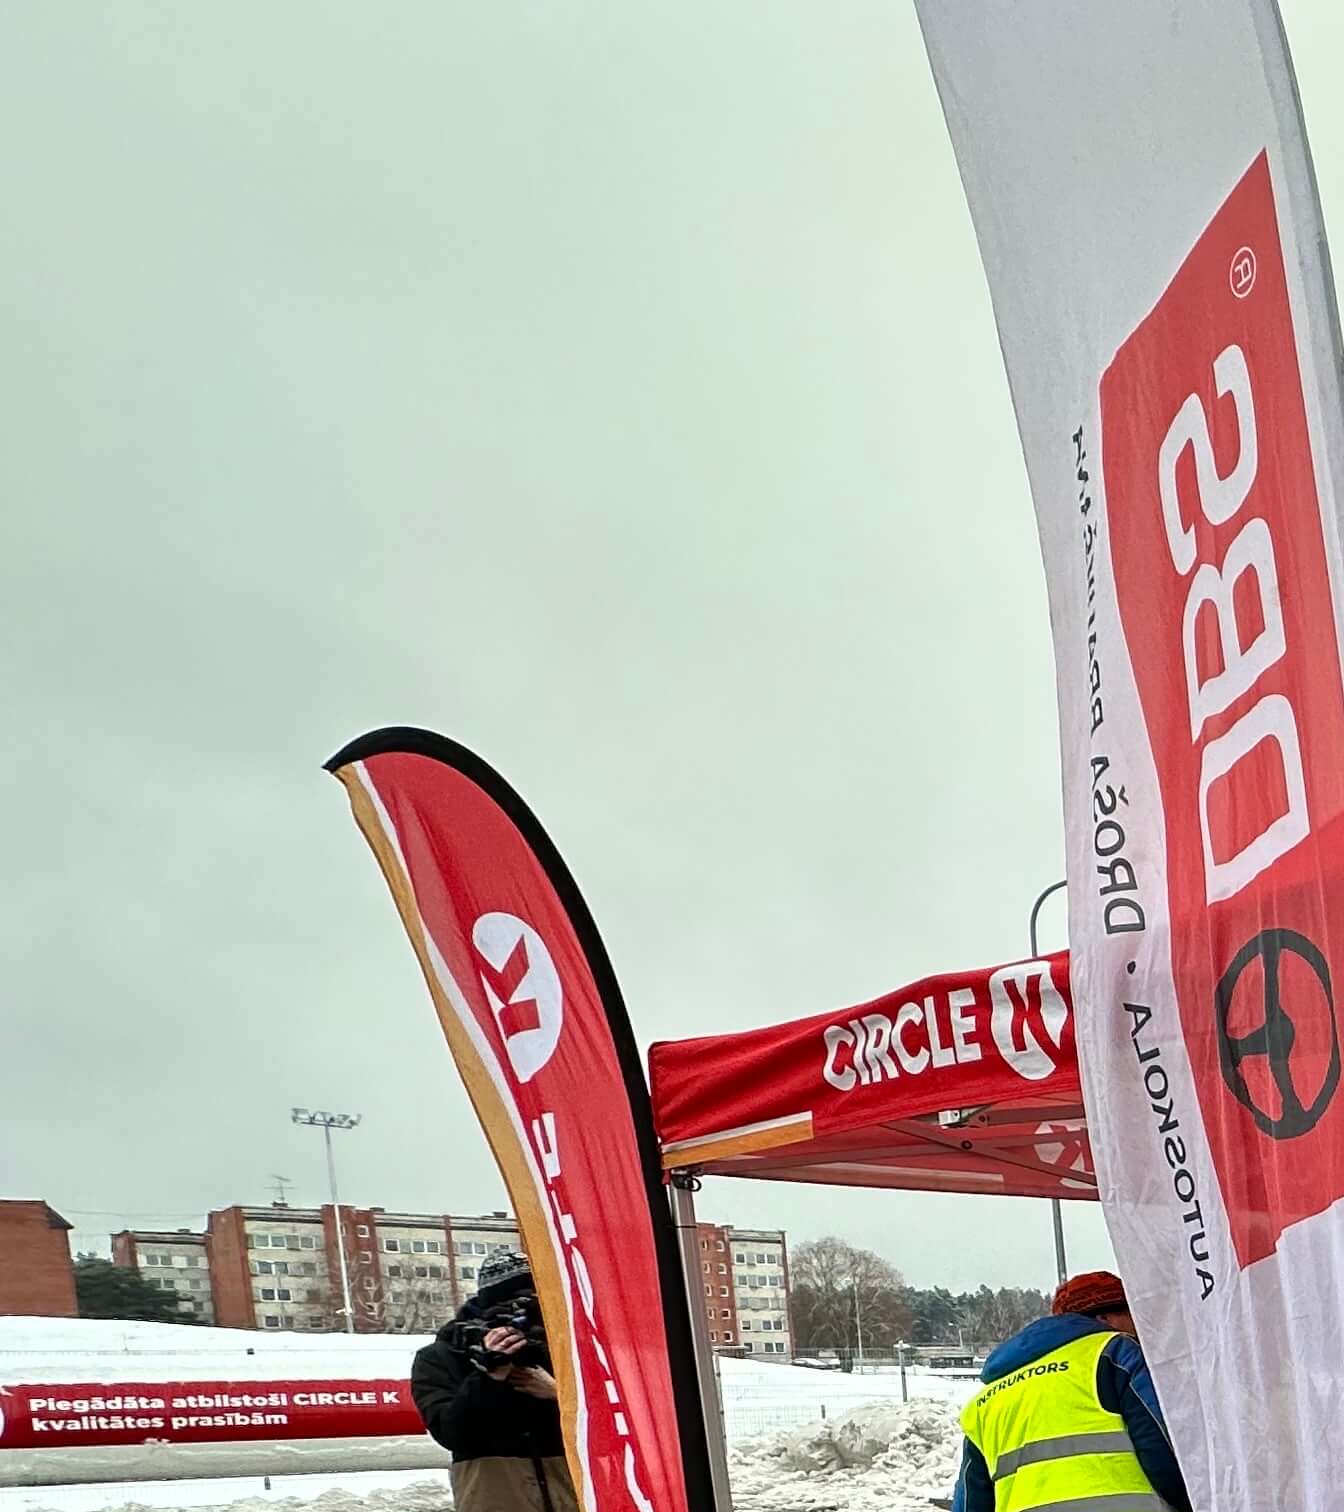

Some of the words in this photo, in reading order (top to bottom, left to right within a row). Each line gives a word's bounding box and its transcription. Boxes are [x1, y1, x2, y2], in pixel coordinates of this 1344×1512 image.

[822, 986, 983, 1092] CIRCLE
[976, 1361, 1070, 1407] INSTRUKTORS
[30, 1397, 165, 1414] Piegādāta
[172, 1393, 288, 1409] atbilstoši
[293, 1391, 377, 1406] CIRCLE
[383, 1391, 400, 1404] K
[32, 1414, 165, 1431] kvalitātes
[172, 1411, 288, 1430] prasībām
